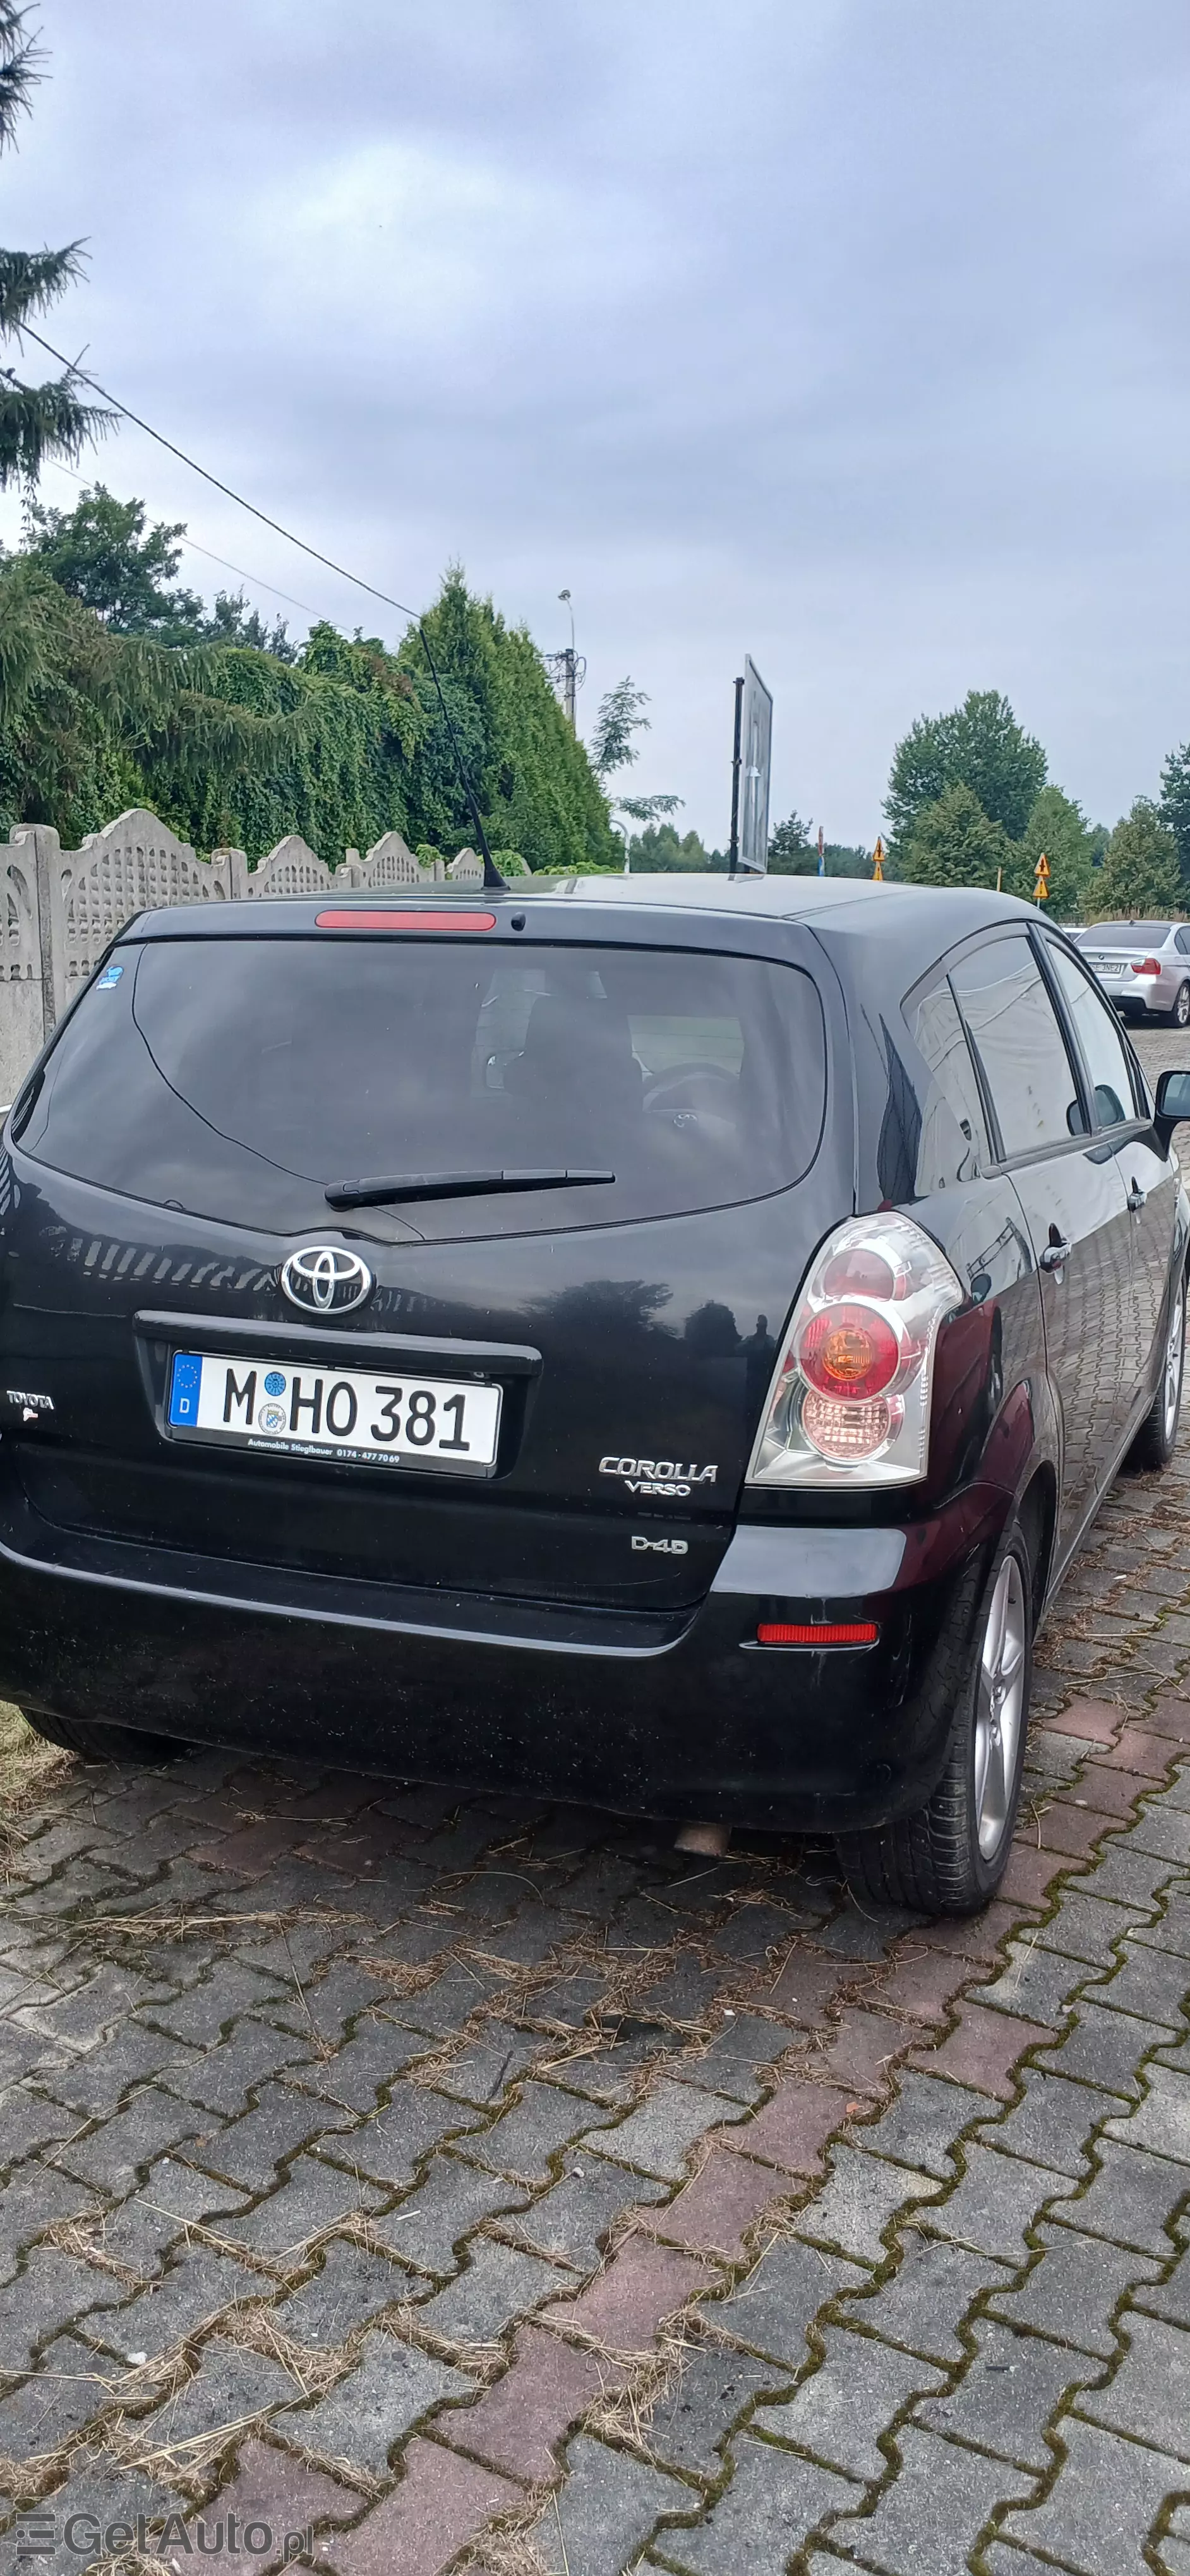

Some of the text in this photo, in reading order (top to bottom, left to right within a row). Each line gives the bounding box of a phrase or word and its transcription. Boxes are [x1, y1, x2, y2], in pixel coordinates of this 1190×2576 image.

[6, 1390, 55, 1410] TOYOTA
[179, 1398, 190, 1414] D
[223, 1368, 257, 1425] M
[289, 1376, 358, 1436] HO
[370, 1385, 471, 1452] 381
[248, 1438, 289, 1451] Automobile
[291, 1443, 333, 1455] Stieglbauer
[599, 1457, 719, 1482] COROLLA
[625, 1480, 691, 1496] VERSO
[632, 1536, 688, 1554] D-4D
